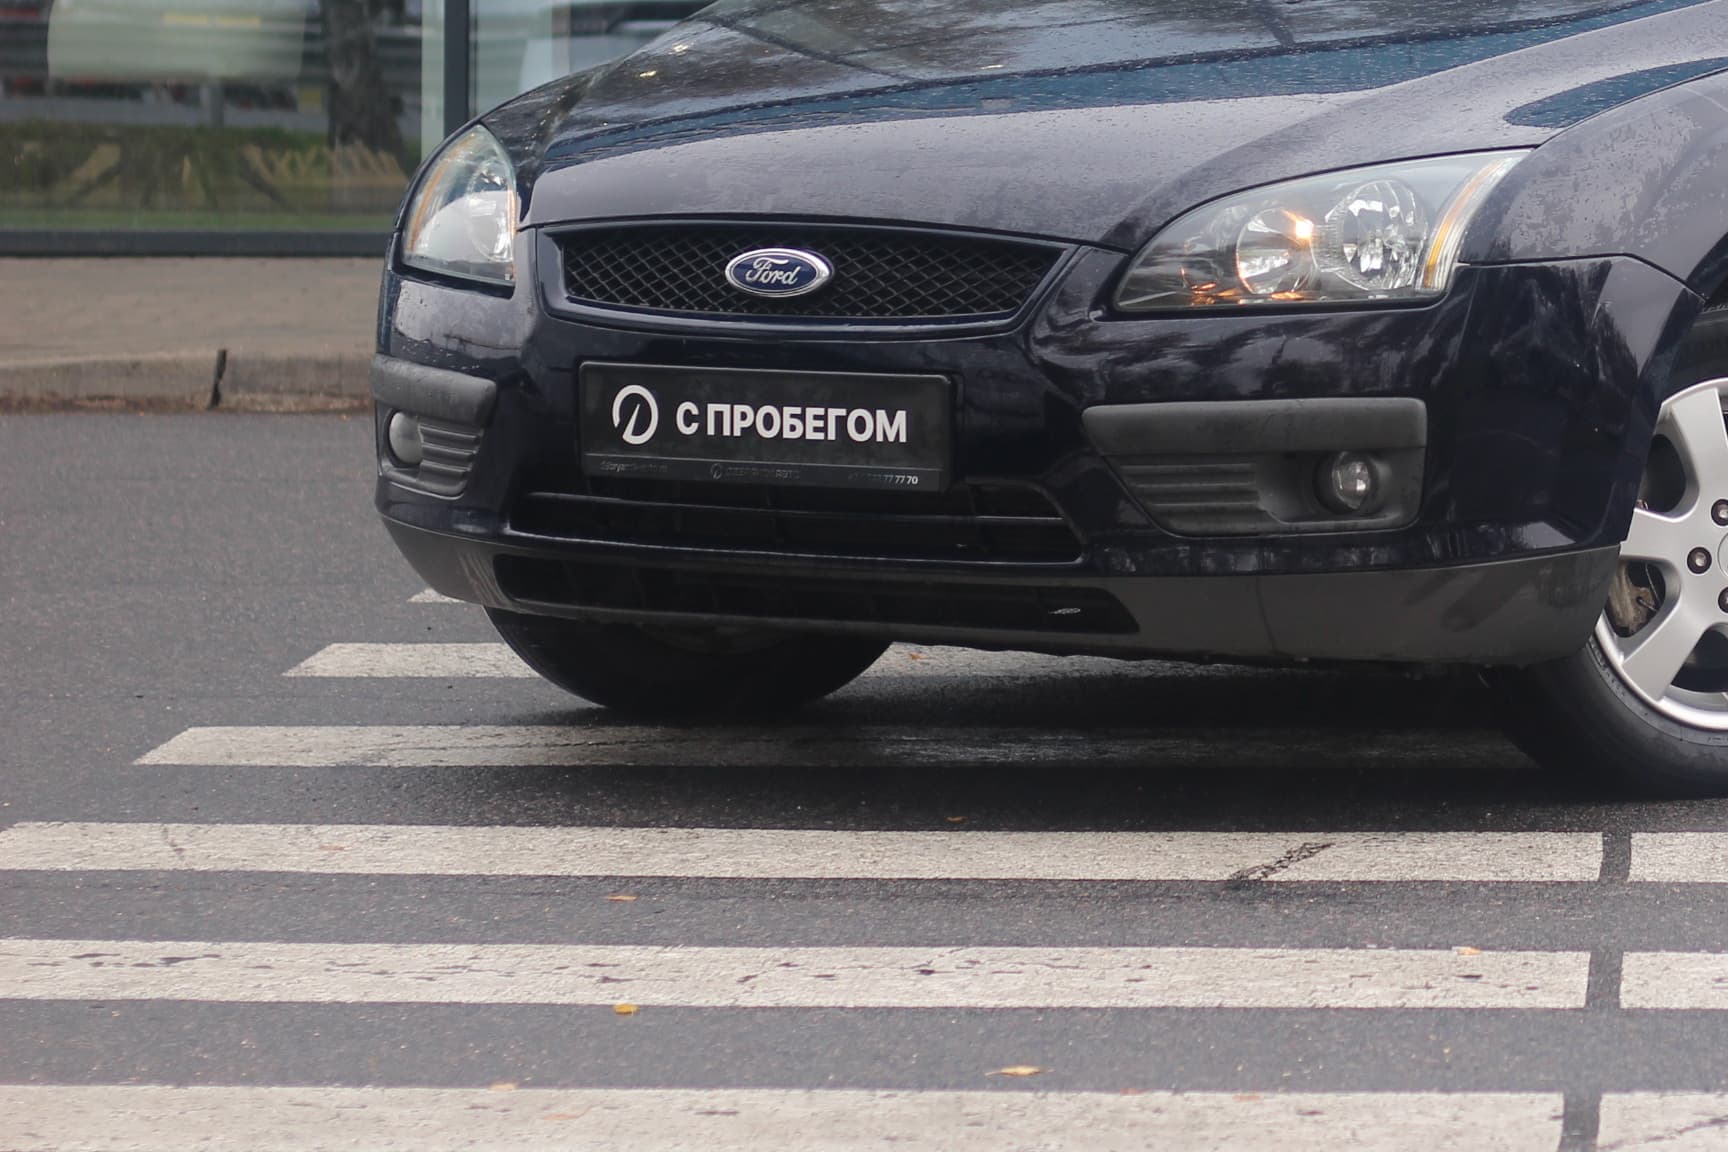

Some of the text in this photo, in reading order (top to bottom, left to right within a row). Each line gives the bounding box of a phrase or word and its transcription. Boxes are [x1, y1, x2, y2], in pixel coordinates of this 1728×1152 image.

[745, 256, 801, 286] Ford
[675, 400, 908, 444] С ПРОБЕГОМ
